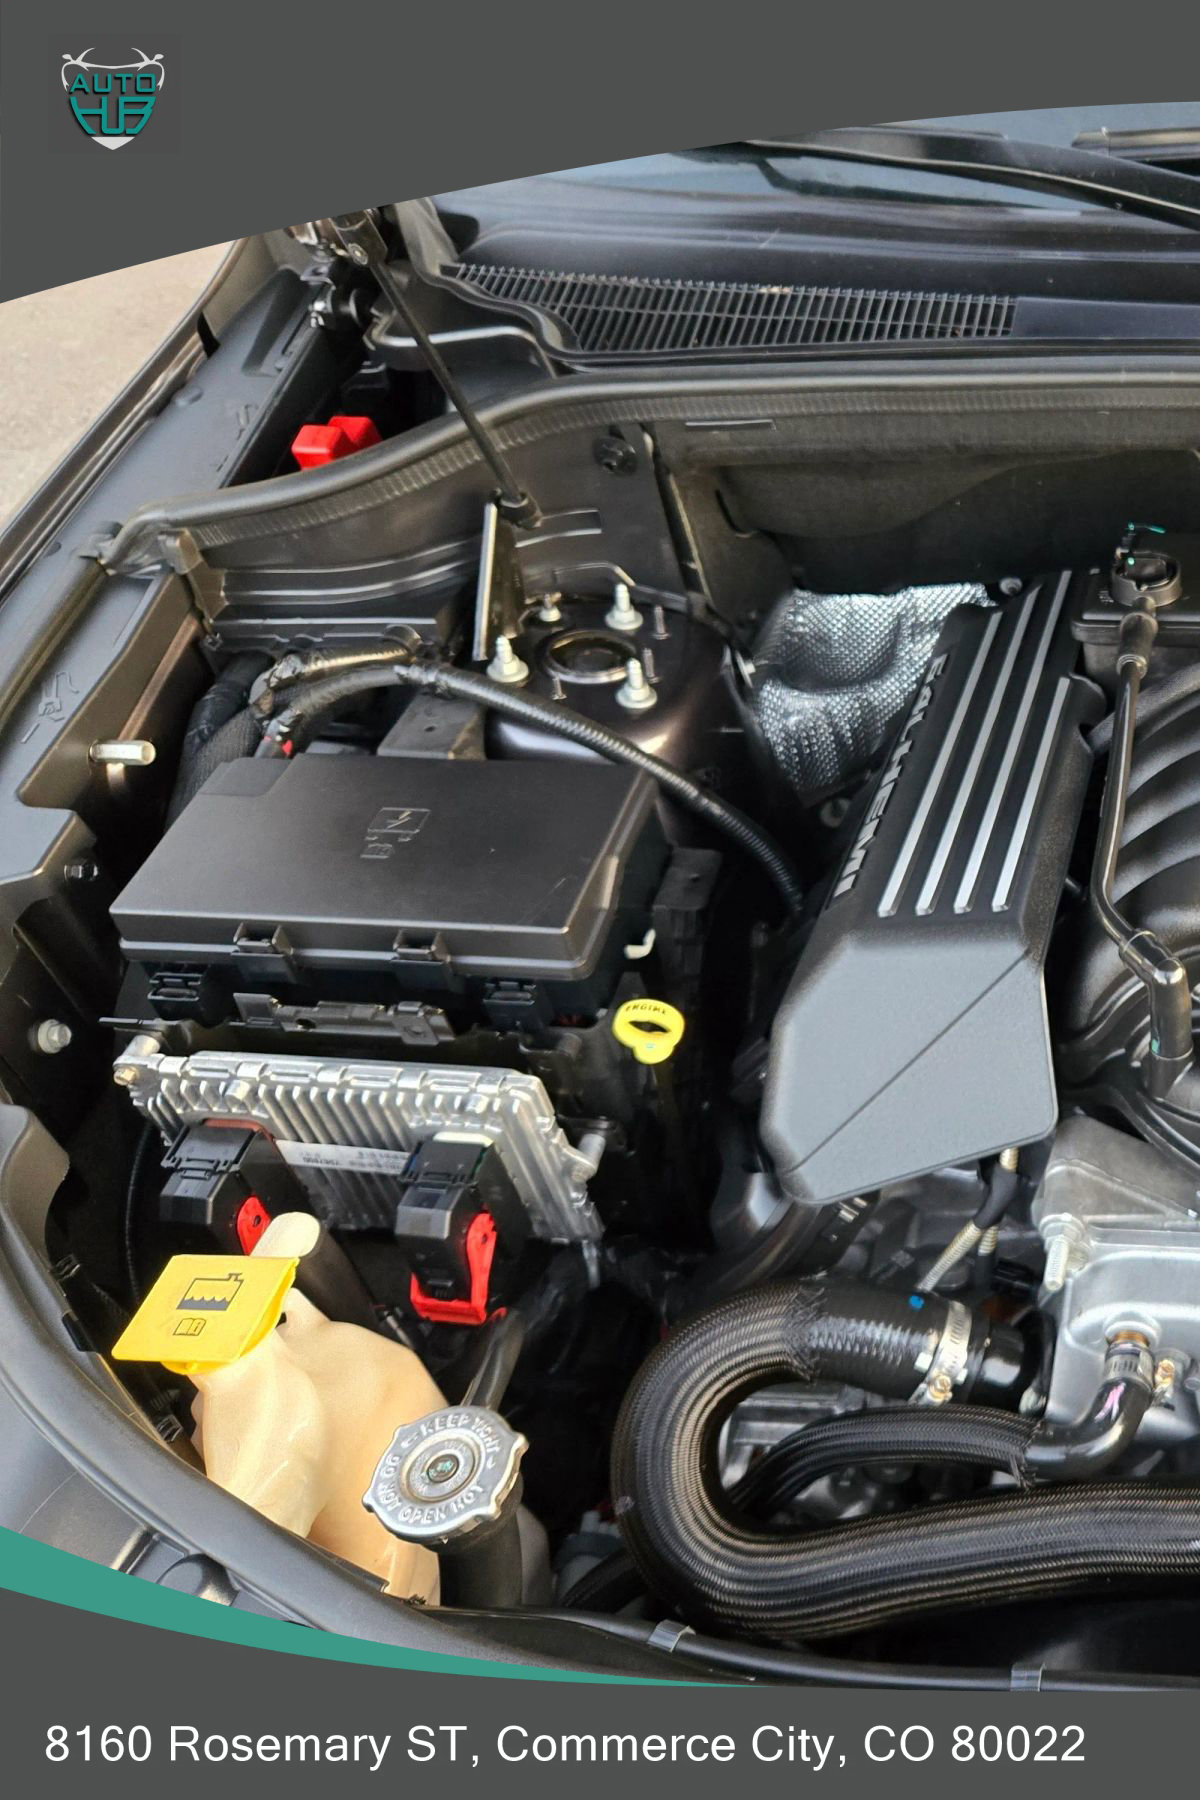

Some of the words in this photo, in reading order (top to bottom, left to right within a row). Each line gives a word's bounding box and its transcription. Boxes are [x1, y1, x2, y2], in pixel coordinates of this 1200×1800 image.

[834, 740, 913, 897] HEMI
[419, 1412, 473, 1438] KEEP
[397, 1504, 449, 1525] OPEN
[450, 1484, 484, 1514] HOT
